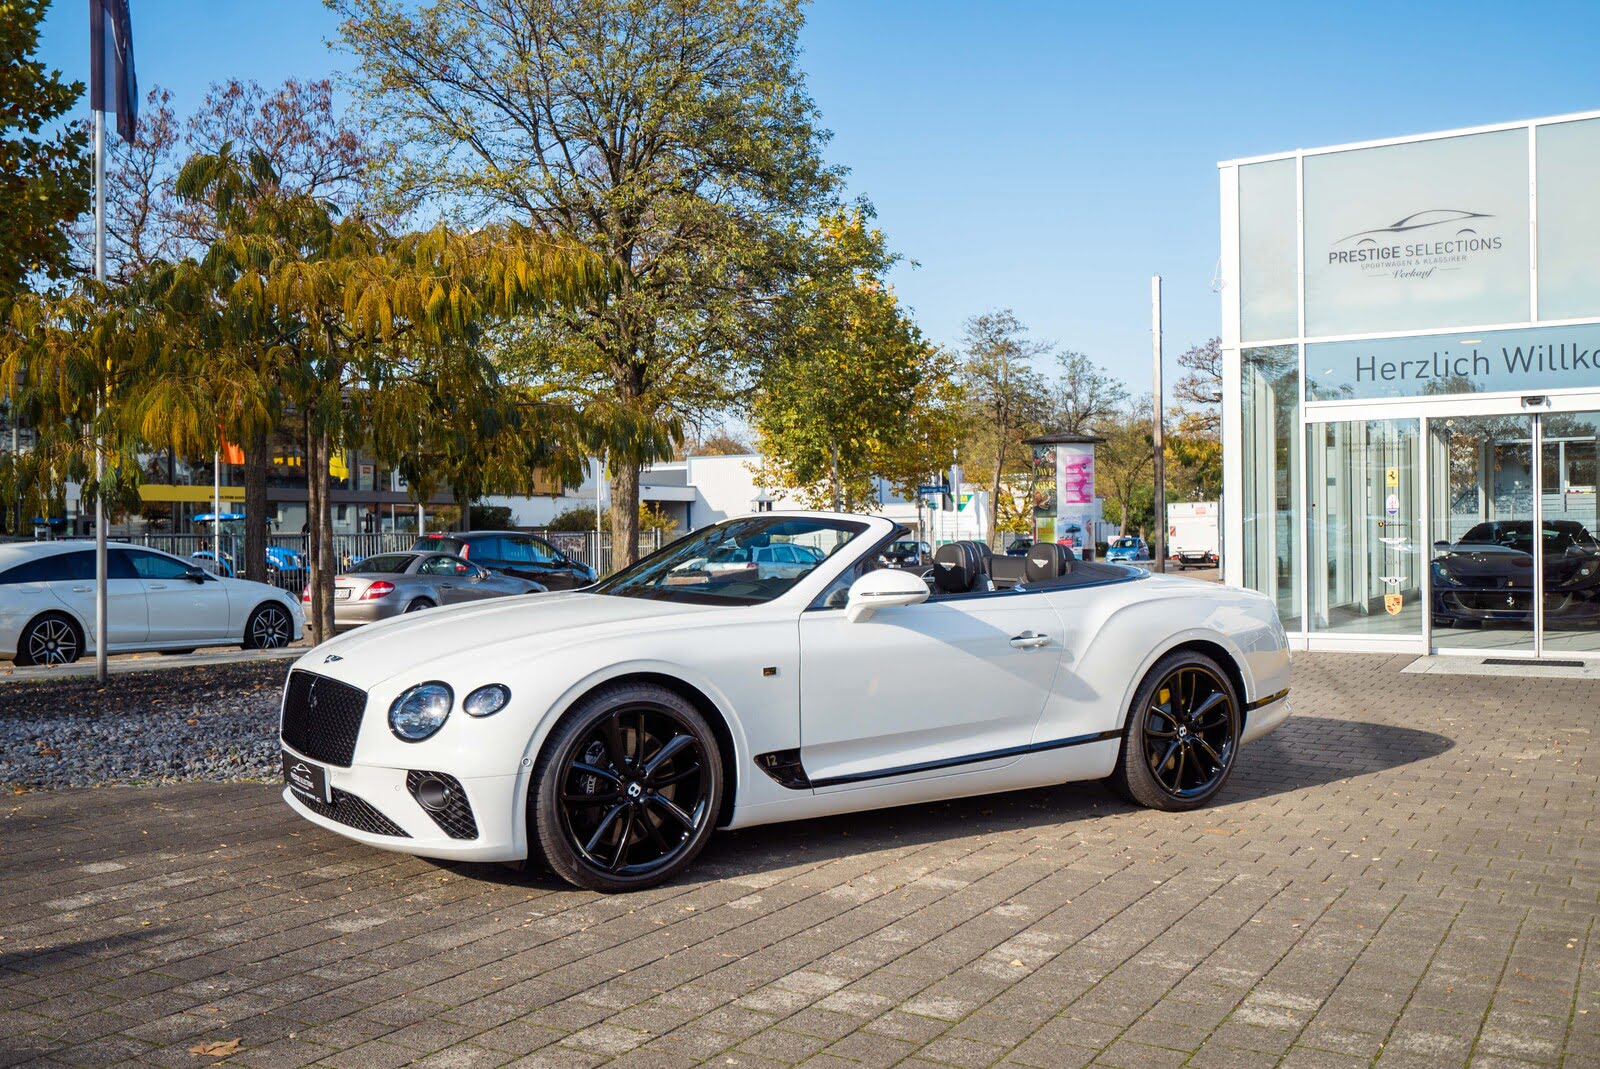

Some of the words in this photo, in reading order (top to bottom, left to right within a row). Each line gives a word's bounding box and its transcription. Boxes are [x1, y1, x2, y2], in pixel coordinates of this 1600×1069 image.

[1328, 246, 1401, 264] PRESTIGE
[1405, 237, 1502, 257] SELECTIONS
[1360, 260, 1412, 270] SPORTWAGEN
[1423, 255, 1467, 265] KLASSIKER
[1392, 266, 1437, 279] Verkauf
[1356, 349, 1490, 382] Herzlich
